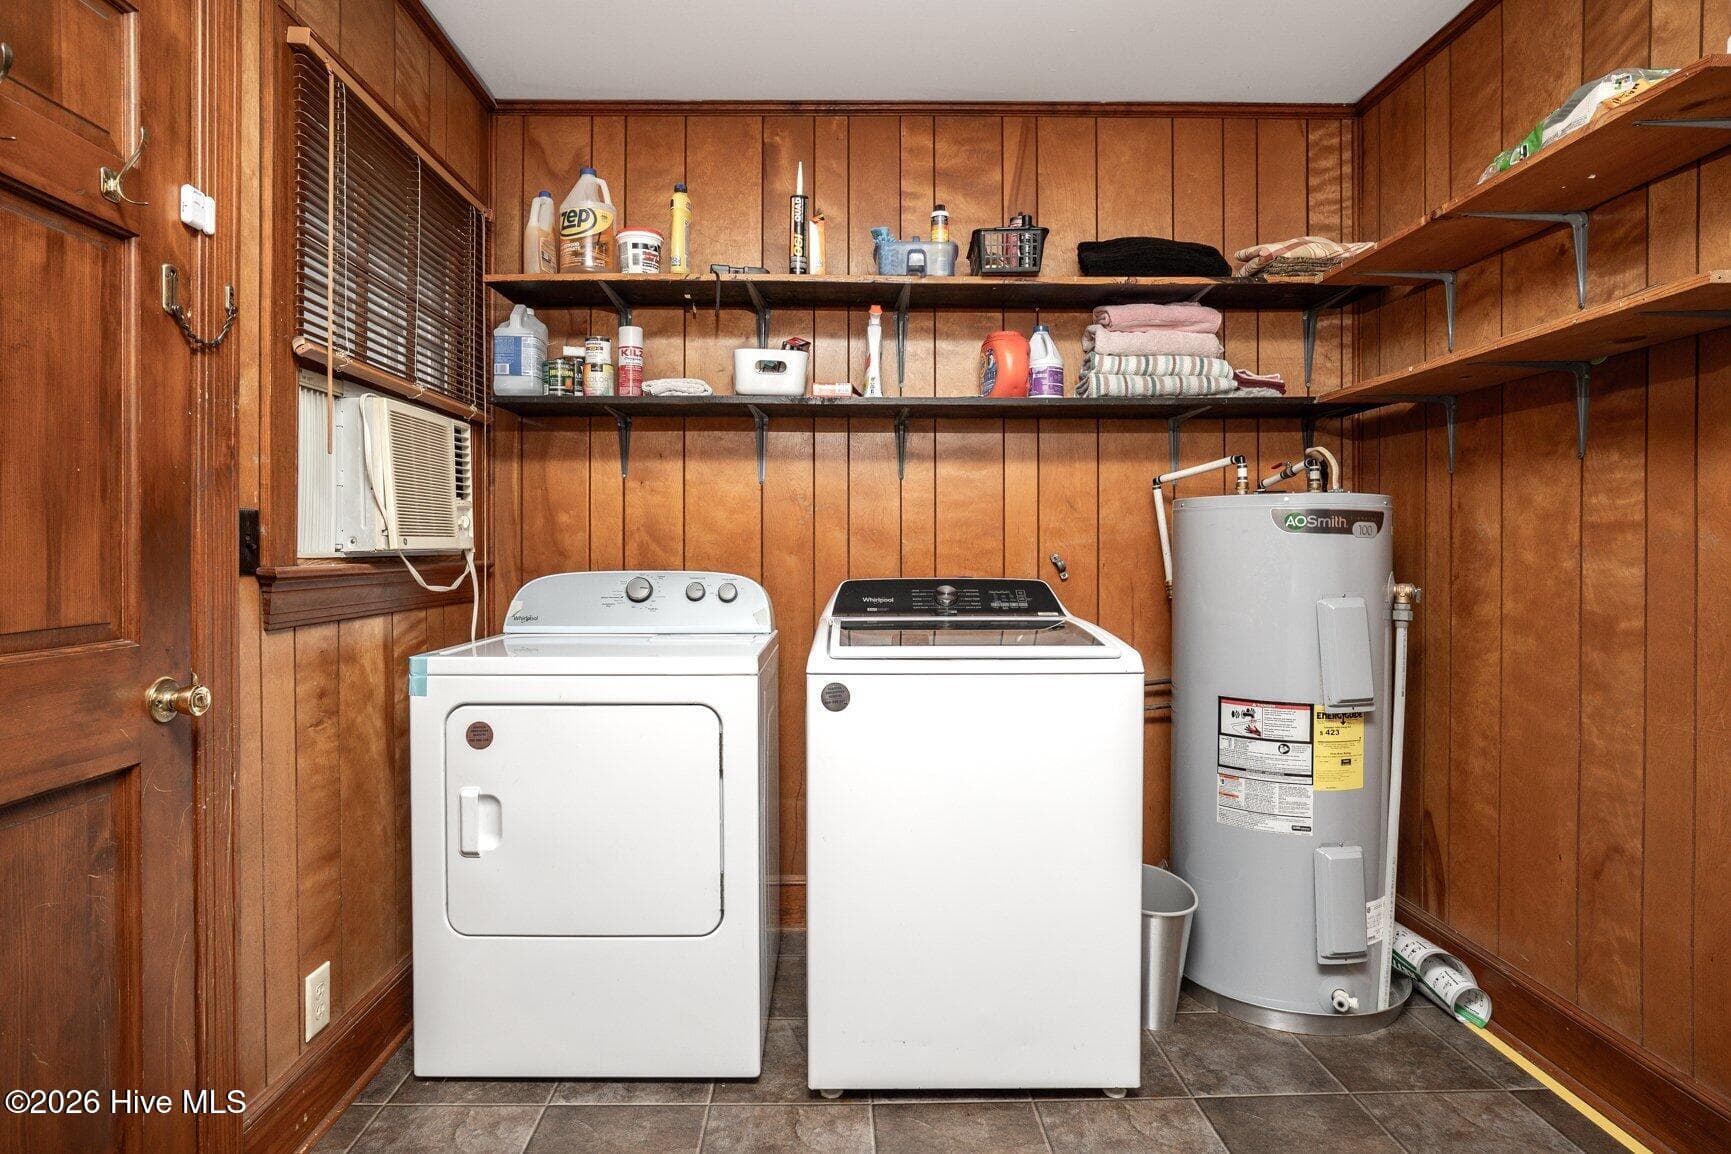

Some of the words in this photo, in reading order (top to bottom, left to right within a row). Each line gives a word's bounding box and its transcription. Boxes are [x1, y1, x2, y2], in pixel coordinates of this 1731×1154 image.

[794, 197, 803, 223] QUAD
[794, 234, 803, 256] OSI
[1358, 524, 1373, 536] 100
[862, 597, 895, 605] Whirlpool
[511, 615, 539, 624] Whirlpool
